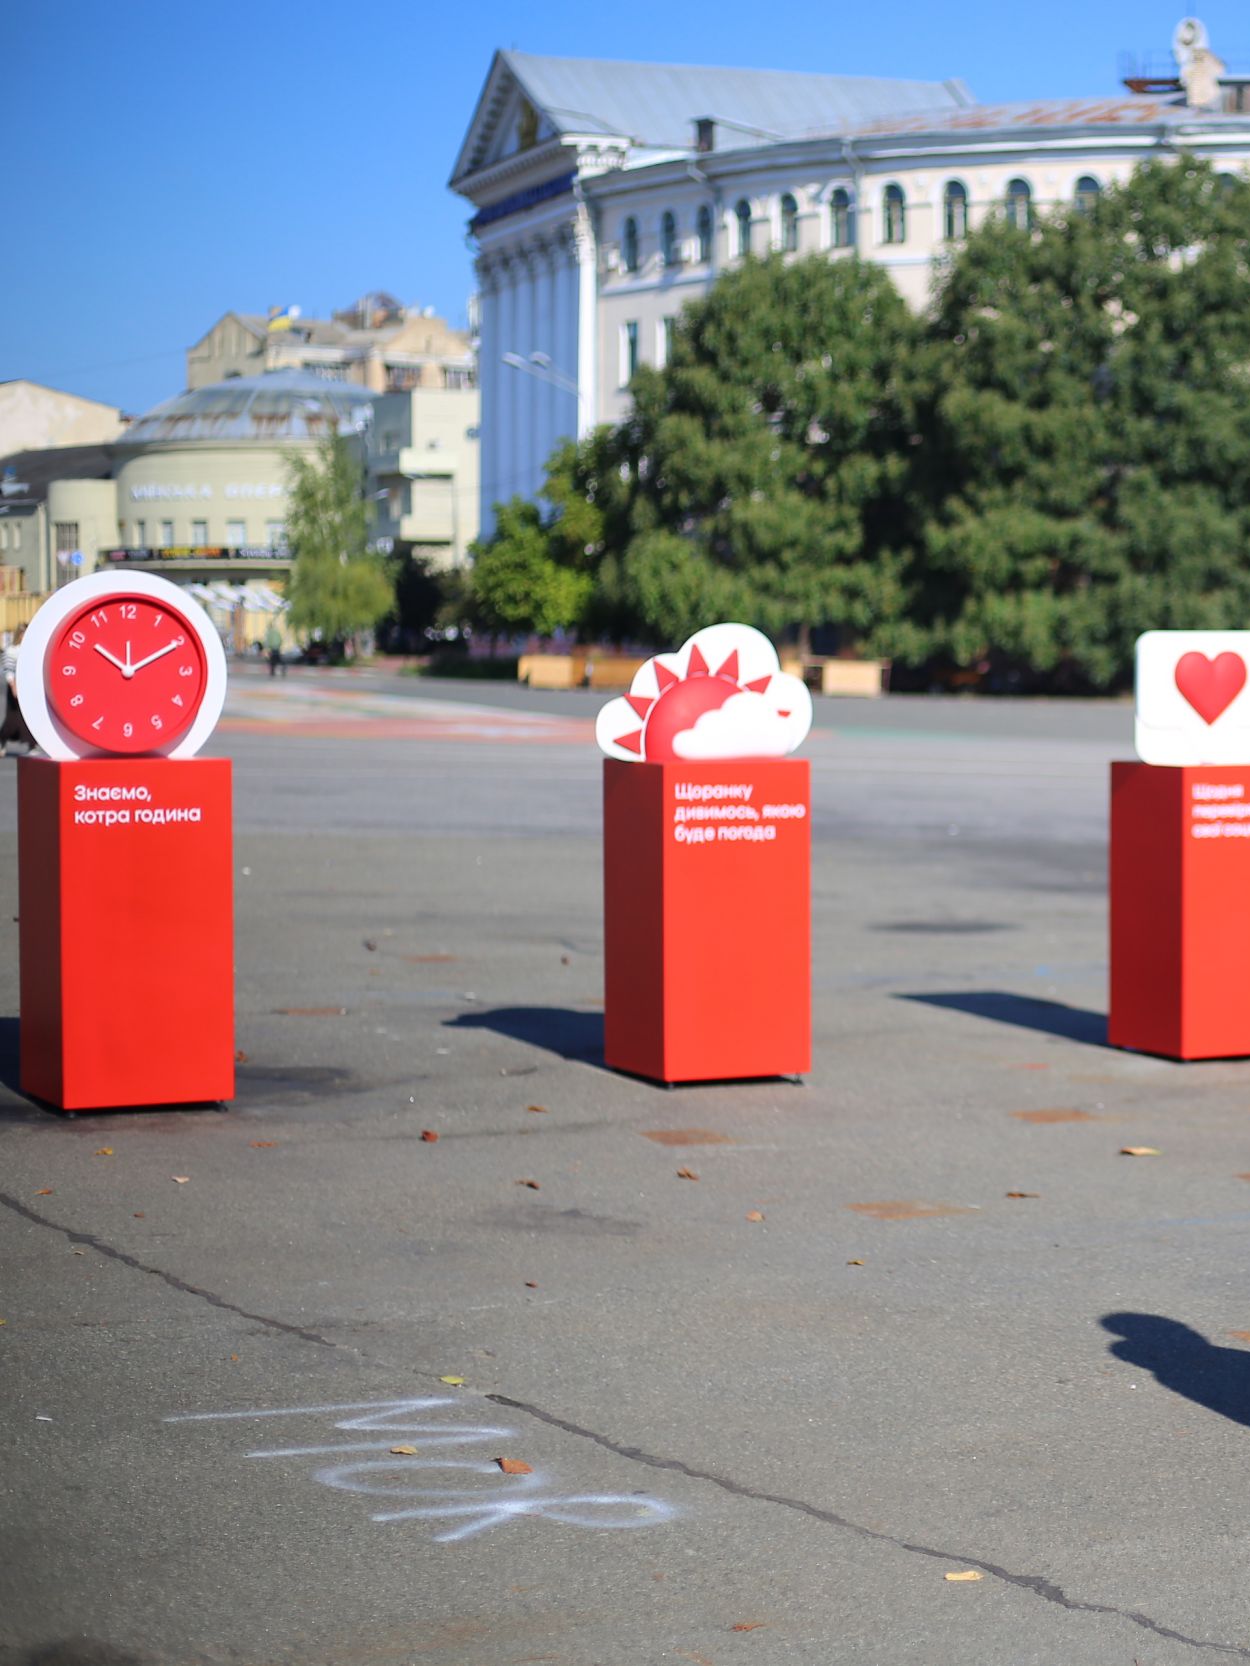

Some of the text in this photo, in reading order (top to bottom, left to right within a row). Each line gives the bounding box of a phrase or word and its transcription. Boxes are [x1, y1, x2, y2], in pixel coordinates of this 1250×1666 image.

[90, 610, 108, 627] 11
[119, 605, 136, 619] 12
[154, 614, 163, 627] 1
[68, 631, 86, 649] 10
[62, 665, 76, 676] 9
[179, 666, 193, 677] 3
[70, 694, 84, 706] 8
[171, 694, 184, 706] 4
[92, 716, 104, 730] 7
[151, 715, 163, 730] 5
[123, 723, 133, 737] 6
[74, 784, 152, 802] Знаємо,
[674, 783, 754, 802] Щоранку
[74, 807, 202, 827] котра година
[673, 803, 807, 822] дивимось, якою
[674, 823, 777, 844] буде погода
